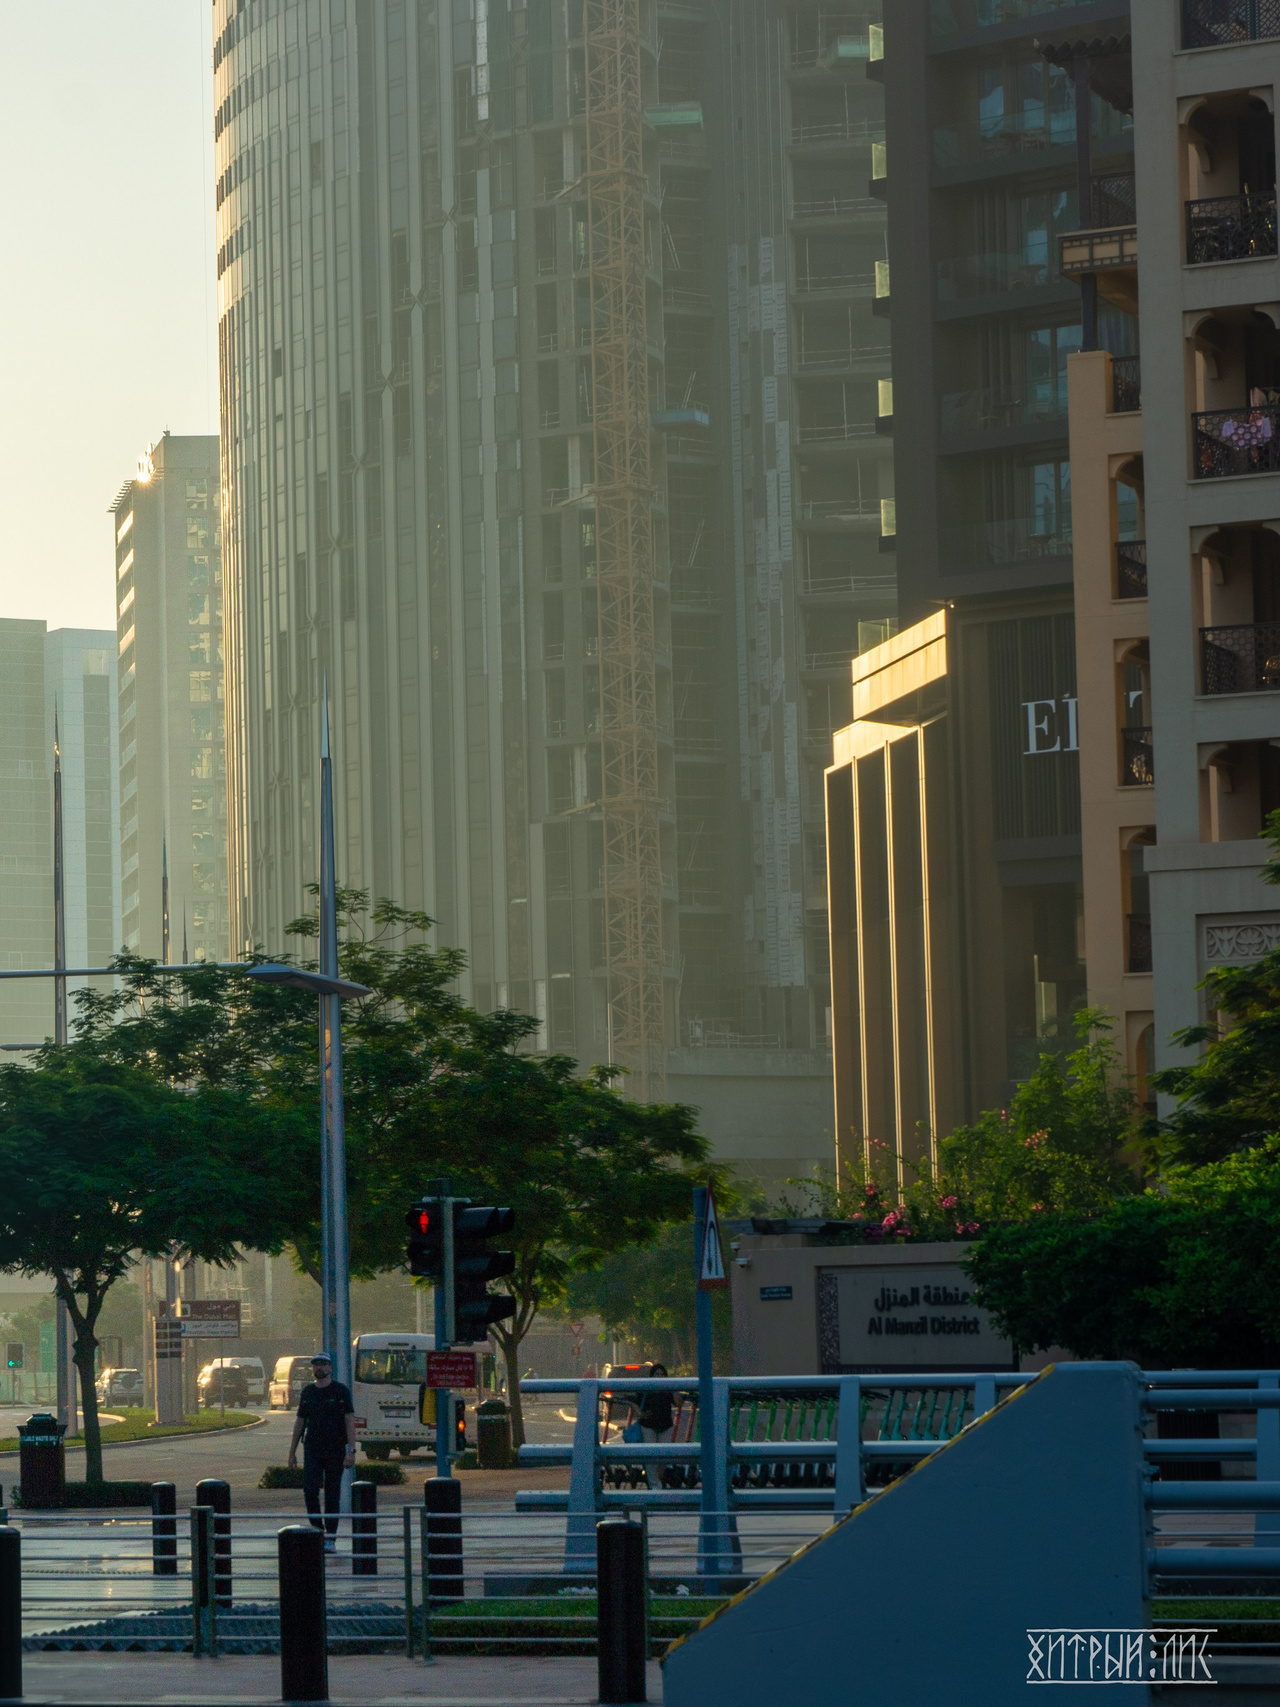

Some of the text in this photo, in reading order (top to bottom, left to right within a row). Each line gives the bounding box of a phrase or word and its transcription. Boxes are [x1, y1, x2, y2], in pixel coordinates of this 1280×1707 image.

[874, 1287, 920, 1312] المنزل
[867, 1316, 980, 1335] Al Manzil District
